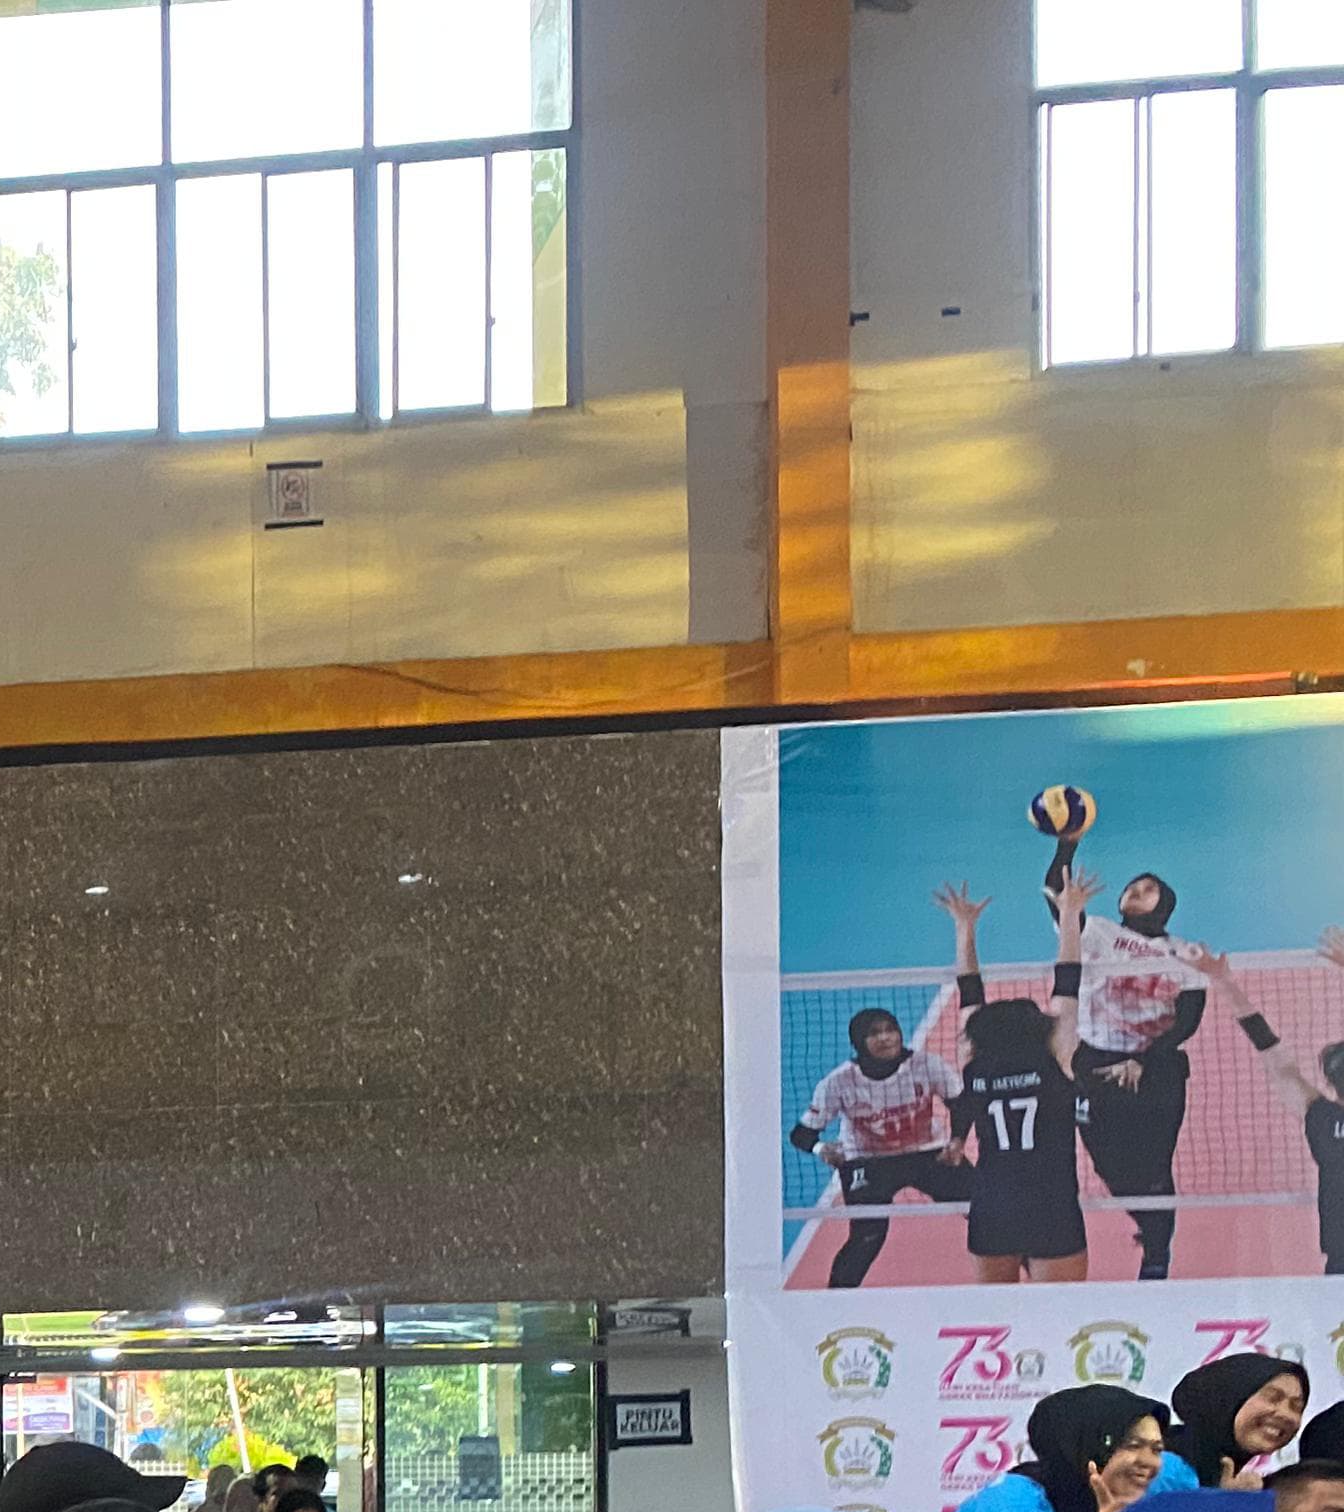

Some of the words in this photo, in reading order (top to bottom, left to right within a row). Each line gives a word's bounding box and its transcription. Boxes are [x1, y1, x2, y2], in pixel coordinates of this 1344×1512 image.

[988, 1096, 1038, 1150] 17
[938, 1325, 1012, 1387] 73
[620, 1419, 680, 1432] KELUAR
[626, 1408, 673, 1421] PINTU
[939, 1416, 1012, 1474] 73
